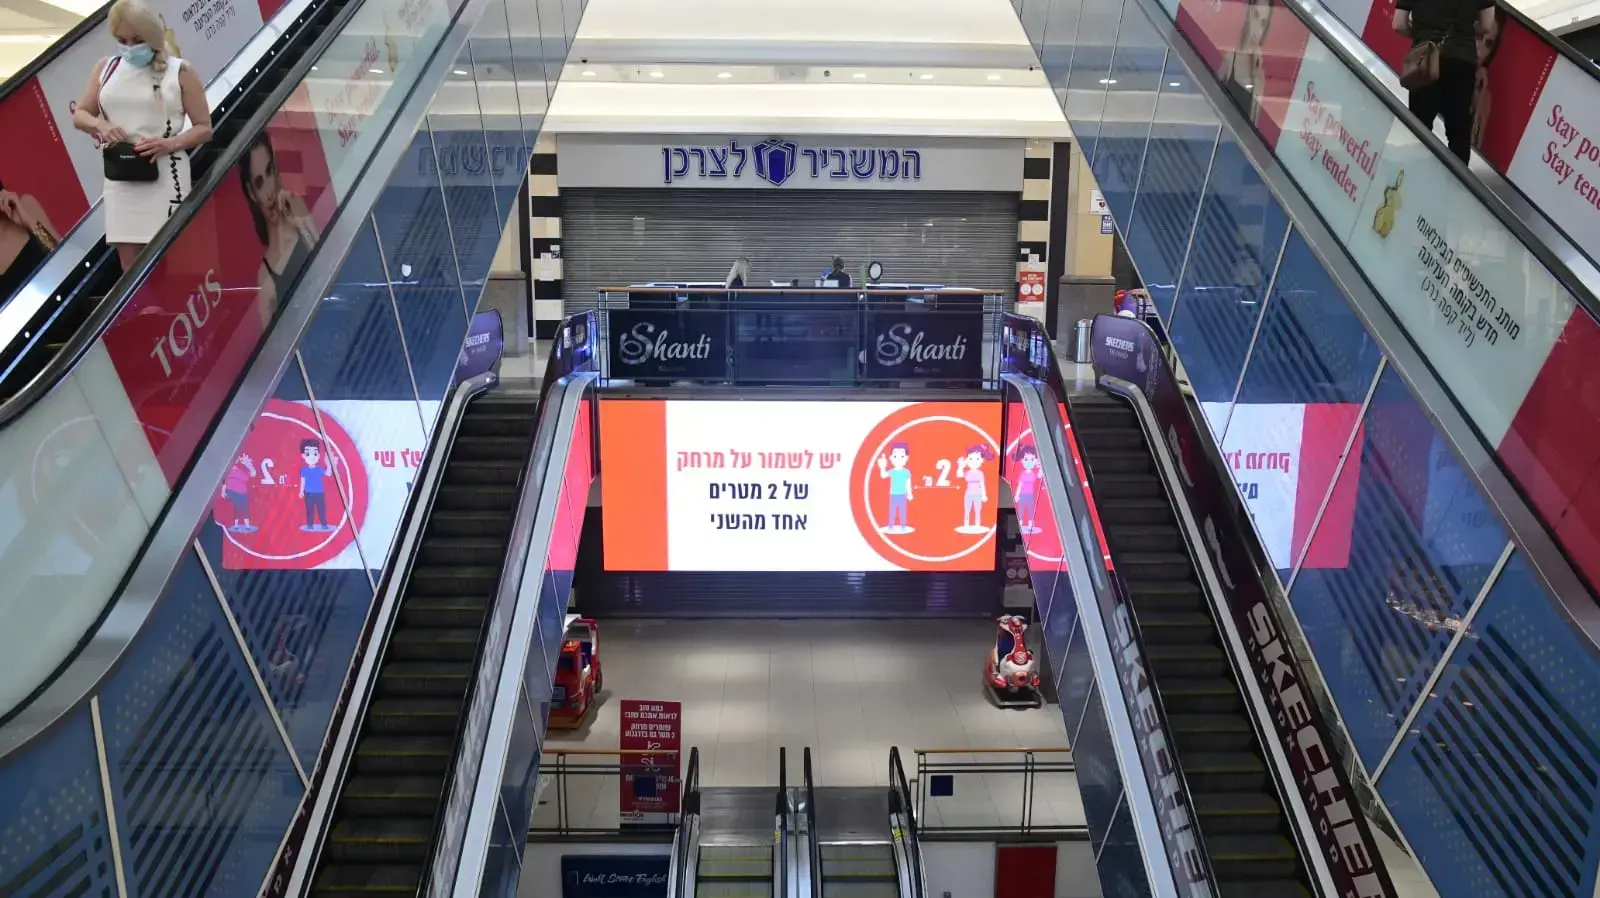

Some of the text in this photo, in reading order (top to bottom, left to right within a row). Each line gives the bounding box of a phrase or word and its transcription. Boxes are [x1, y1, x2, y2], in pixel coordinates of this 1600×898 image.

[1303, 80, 1326, 123] Stay
[1547, 104, 1580, 148] Stay
[662, 140, 921, 184] המשביר לצרכן
[1300, 118, 1356, 203] Stay tender.
[1542, 141, 1575, 185] Stay
[1416, 213, 1454, 265] הבינלאומי
[1418, 245, 1499, 346] חדש בקומה העליונה
[1453, 257, 1497, 313] התכשיטים
[150, 268, 222, 378] TOUS
[1437, 297, 1458, 327] קפה
[619, 321, 712, 366] Shanti
[876, 322, 968, 367] Shanti
[1105, 336, 1135, 352] SKECHERS
[676, 449, 842, 471] יש לשמור על מרחק
[935, 458, 952, 487] 2
[709, 480, 809, 499] של 2 מטרים
[710, 513, 808, 530] אחד מהשני
[1112, 603, 1211, 898] SKECHE
